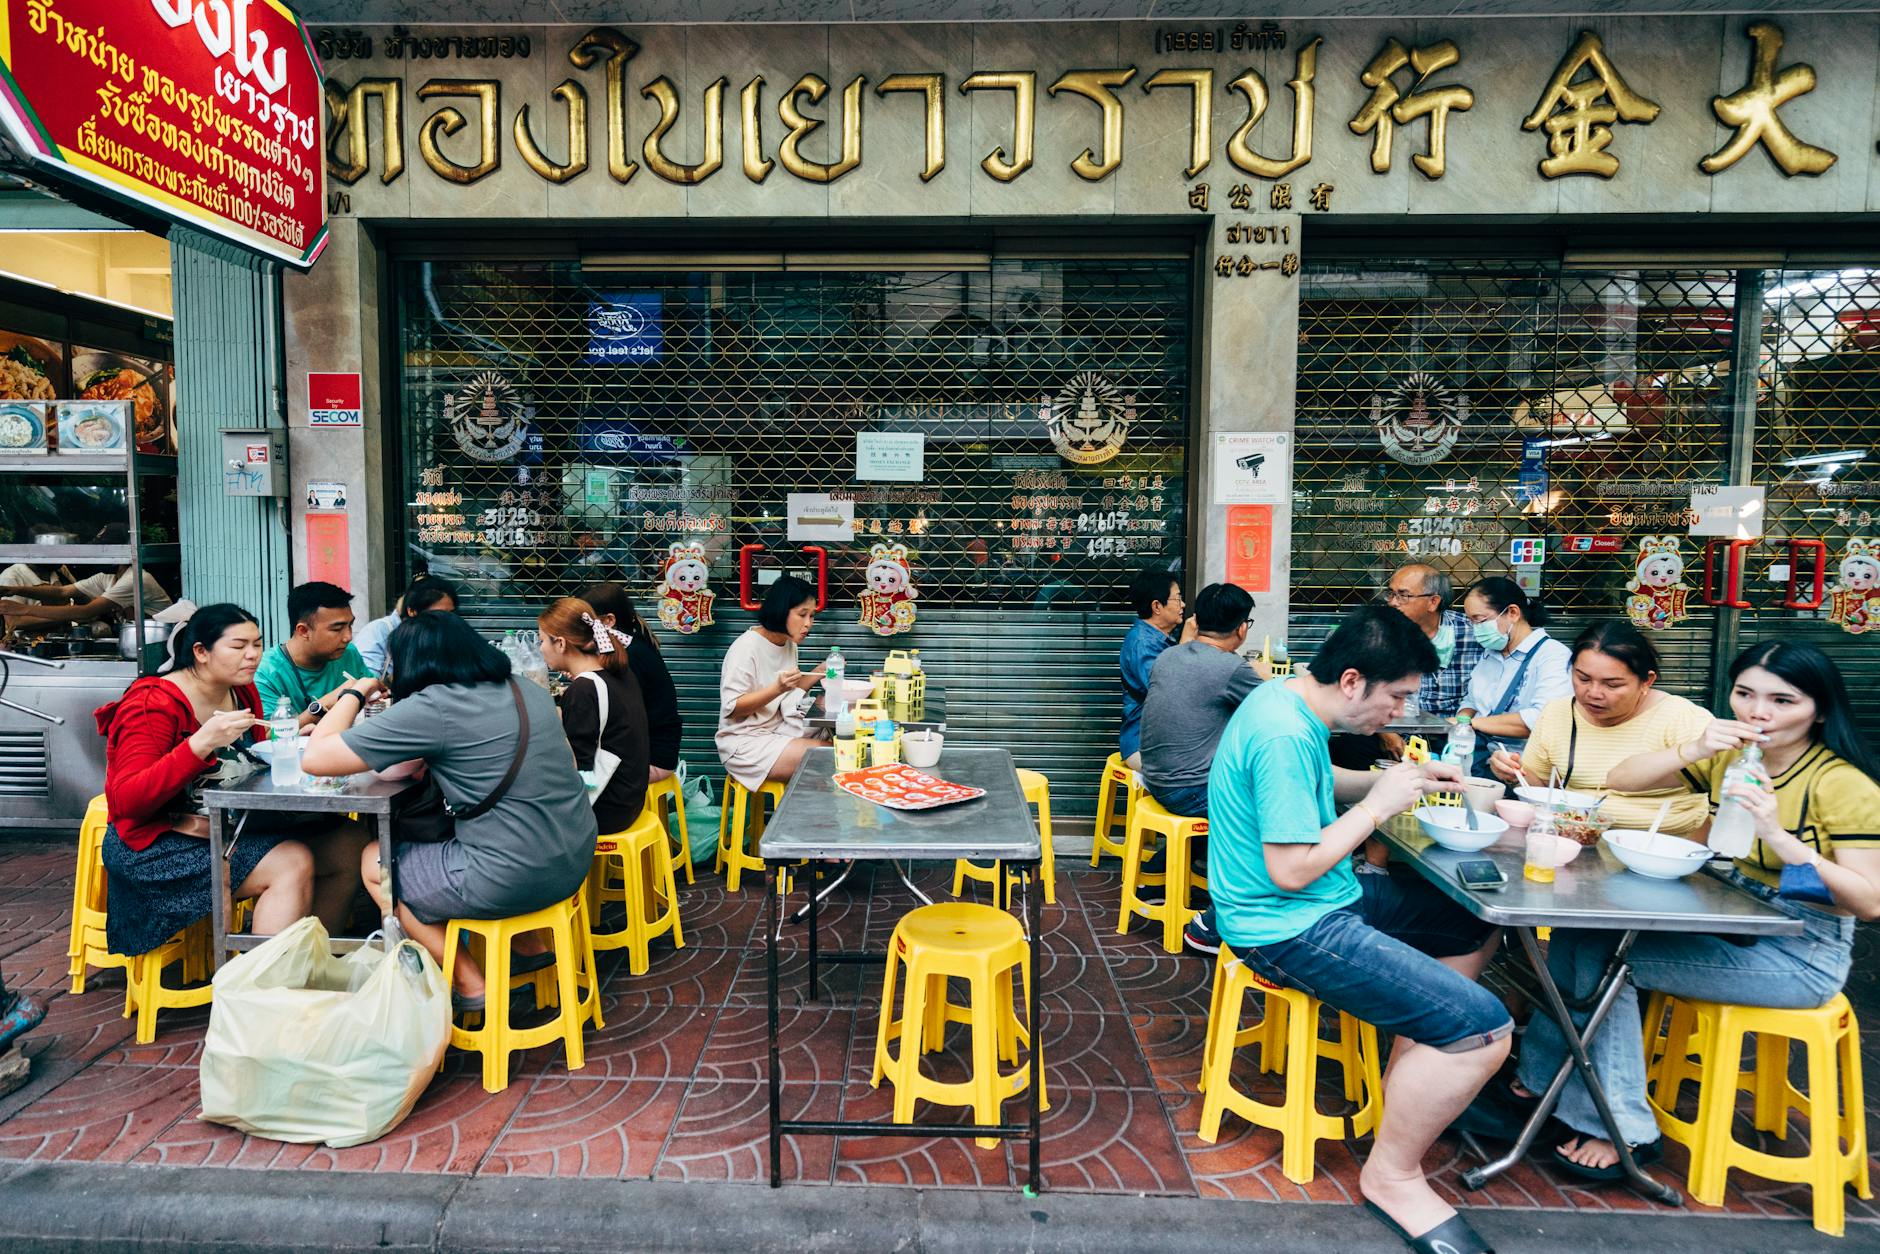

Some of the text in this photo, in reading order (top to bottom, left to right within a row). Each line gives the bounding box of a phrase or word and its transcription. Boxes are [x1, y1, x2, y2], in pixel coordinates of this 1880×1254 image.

[318, 28, 372, 59] ริษัท
[214, 65, 316, 150] เยาวราช
[327, 28, 1323, 185] ทองใบเยาวราช
[1226, 222, 1277, 244] สาขา
[312, 410, 359, 423] SECOM
[643, 510, 728, 531] ยินดีต้อนรับ
[1609, 505, 1701, 527] ยินดีต้อนรับ
[1594, 539, 1615, 548] Closed
